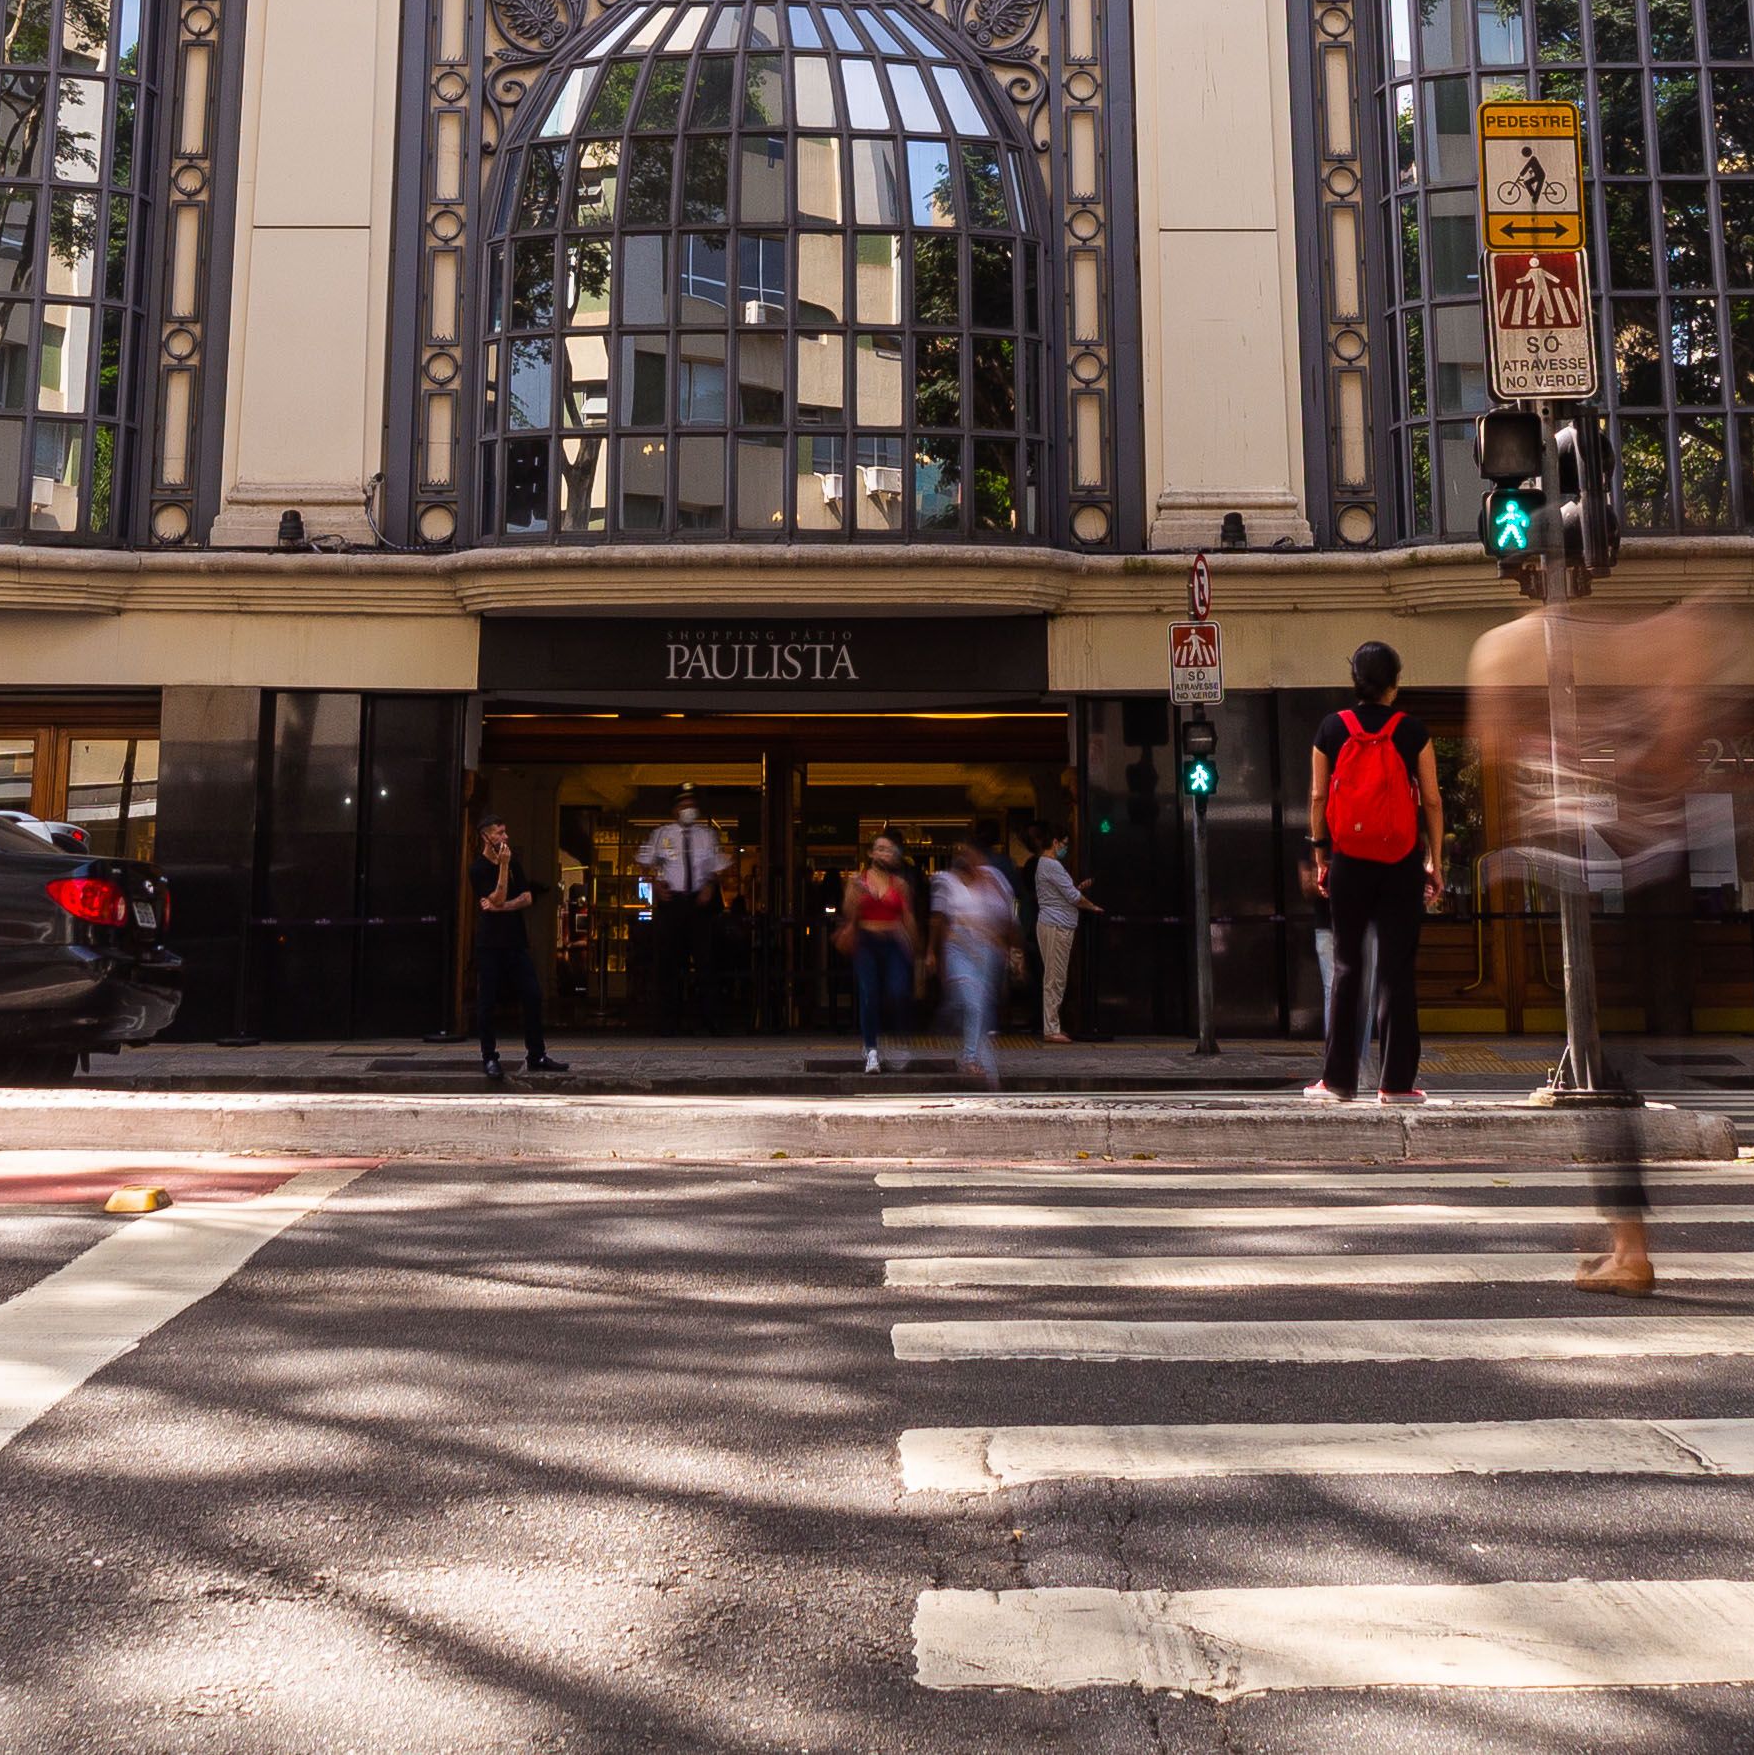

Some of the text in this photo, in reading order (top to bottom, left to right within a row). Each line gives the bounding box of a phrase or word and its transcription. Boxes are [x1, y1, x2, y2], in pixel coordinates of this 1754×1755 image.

[1486, 115, 1572, 128] PEDESTRE
[1526, 331, 1560, 353] SÓ
[1502, 358, 1587, 373] ATRAVESSE
[1506, 374, 1587, 388] NO VERDE
[667, 631, 774, 640] SHOPPING
[665, 644, 859, 680] PAULISTA
[1188, 668, 1205, 681] SÓ
[1175, 682, 1219, 691] ATRAVESSE
[1191, 691, 1219, 699] VERDE
